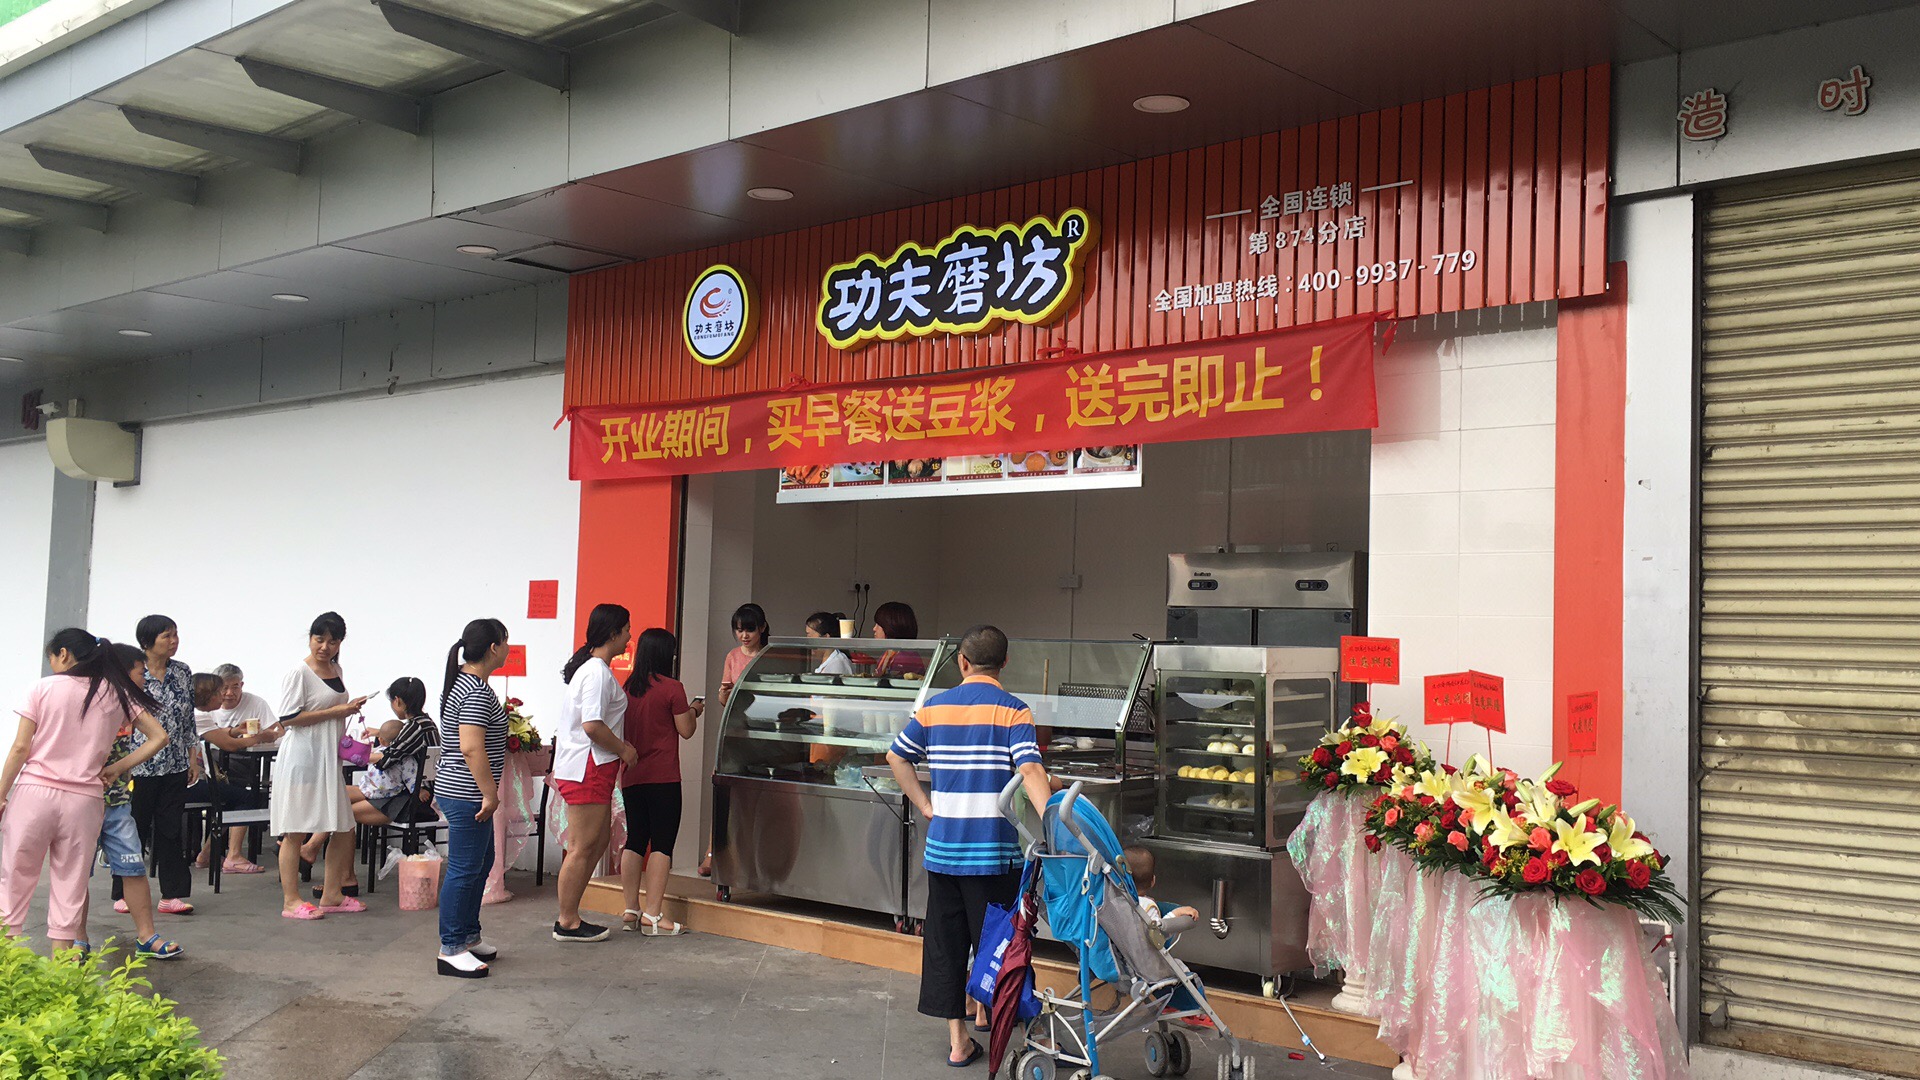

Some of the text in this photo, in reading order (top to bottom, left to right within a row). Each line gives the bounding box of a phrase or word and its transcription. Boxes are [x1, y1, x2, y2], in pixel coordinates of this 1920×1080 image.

[1259, 181, 1354, 220] 全国连锁
[828, 234, 1062, 331] 功夫磨坊
[694, 319, 735, 335] 功夫磨坊
